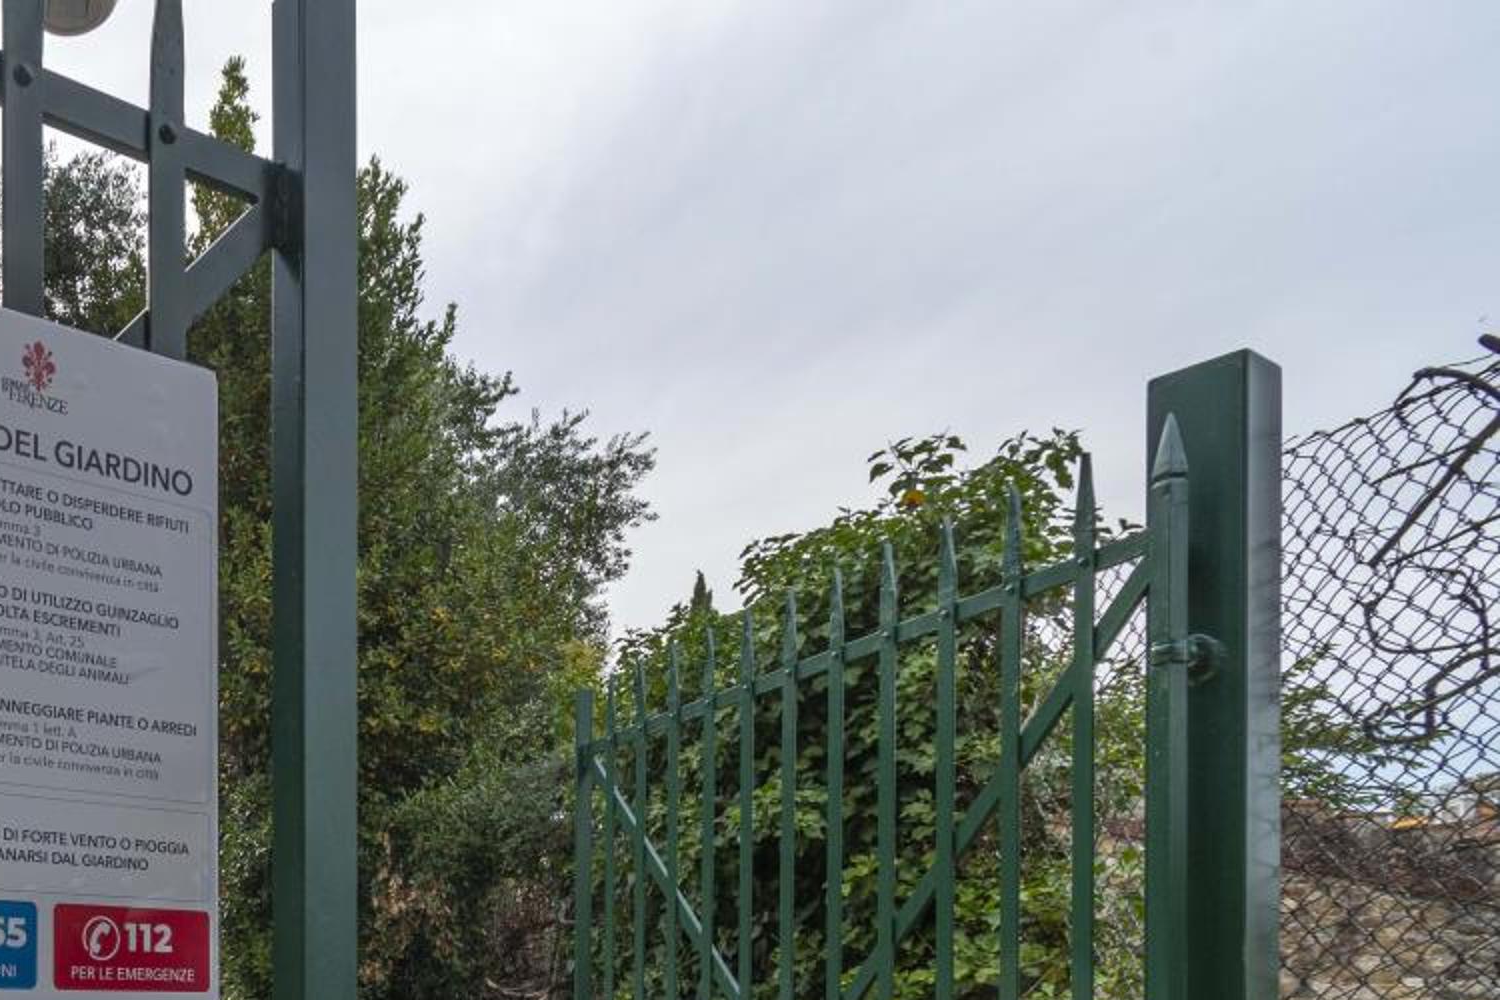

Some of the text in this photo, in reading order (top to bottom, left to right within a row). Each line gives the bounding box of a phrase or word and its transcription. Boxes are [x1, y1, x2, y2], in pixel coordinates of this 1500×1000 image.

[54, 440, 193, 496] GIARDINO
[25, 504, 92, 531] PUBBLICO
[47, 490, 59, 504] O
[63, 493, 143, 523] DISPERDERE
[147, 513, 189, 534] RIFIUTI
[46, 542, 58, 555] DI
[62, 546, 109, 565] POLIZIA
[113, 557, 162, 577] URBANA
[12, 587, 27, 602] DI
[32, 591, 92, 613] UTILIZZO
[96, 603, 179, 629] GUINZAGLIO
[33, 609, 120, 637] ESCREMENTI
[46, 646, 116, 668] COMUNALE
[39, 660, 75, 676] DEGLI
[79, 667, 129, 684] ANIMALI
[67, 726, 77, 738] A
[87, 710, 134, 729] PIANTE
[138, 717, 148, 731] O
[151, 720, 196, 736] ARREDI
[10, 751, 21, 764] la
[24, 755, 53, 769] civile
[46, 739, 58, 752] DI
[62, 741, 109, 757] POLIZIA
[112, 747, 161, 763] URBANA
[3, 828, 18, 842] DI
[22, 829, 66, 846] FORTE
[70, 833, 116, 849] VENTO
[119, 837, 131, 850] O
[136, 839, 189, 855] PIOGGIA
[52, 851, 79, 866] DAL
[82, 853, 149, 871] GIARDINO
[124, 922, 173, 953] 112
[71, 965, 195, 983] PER LE EMERGENZE
